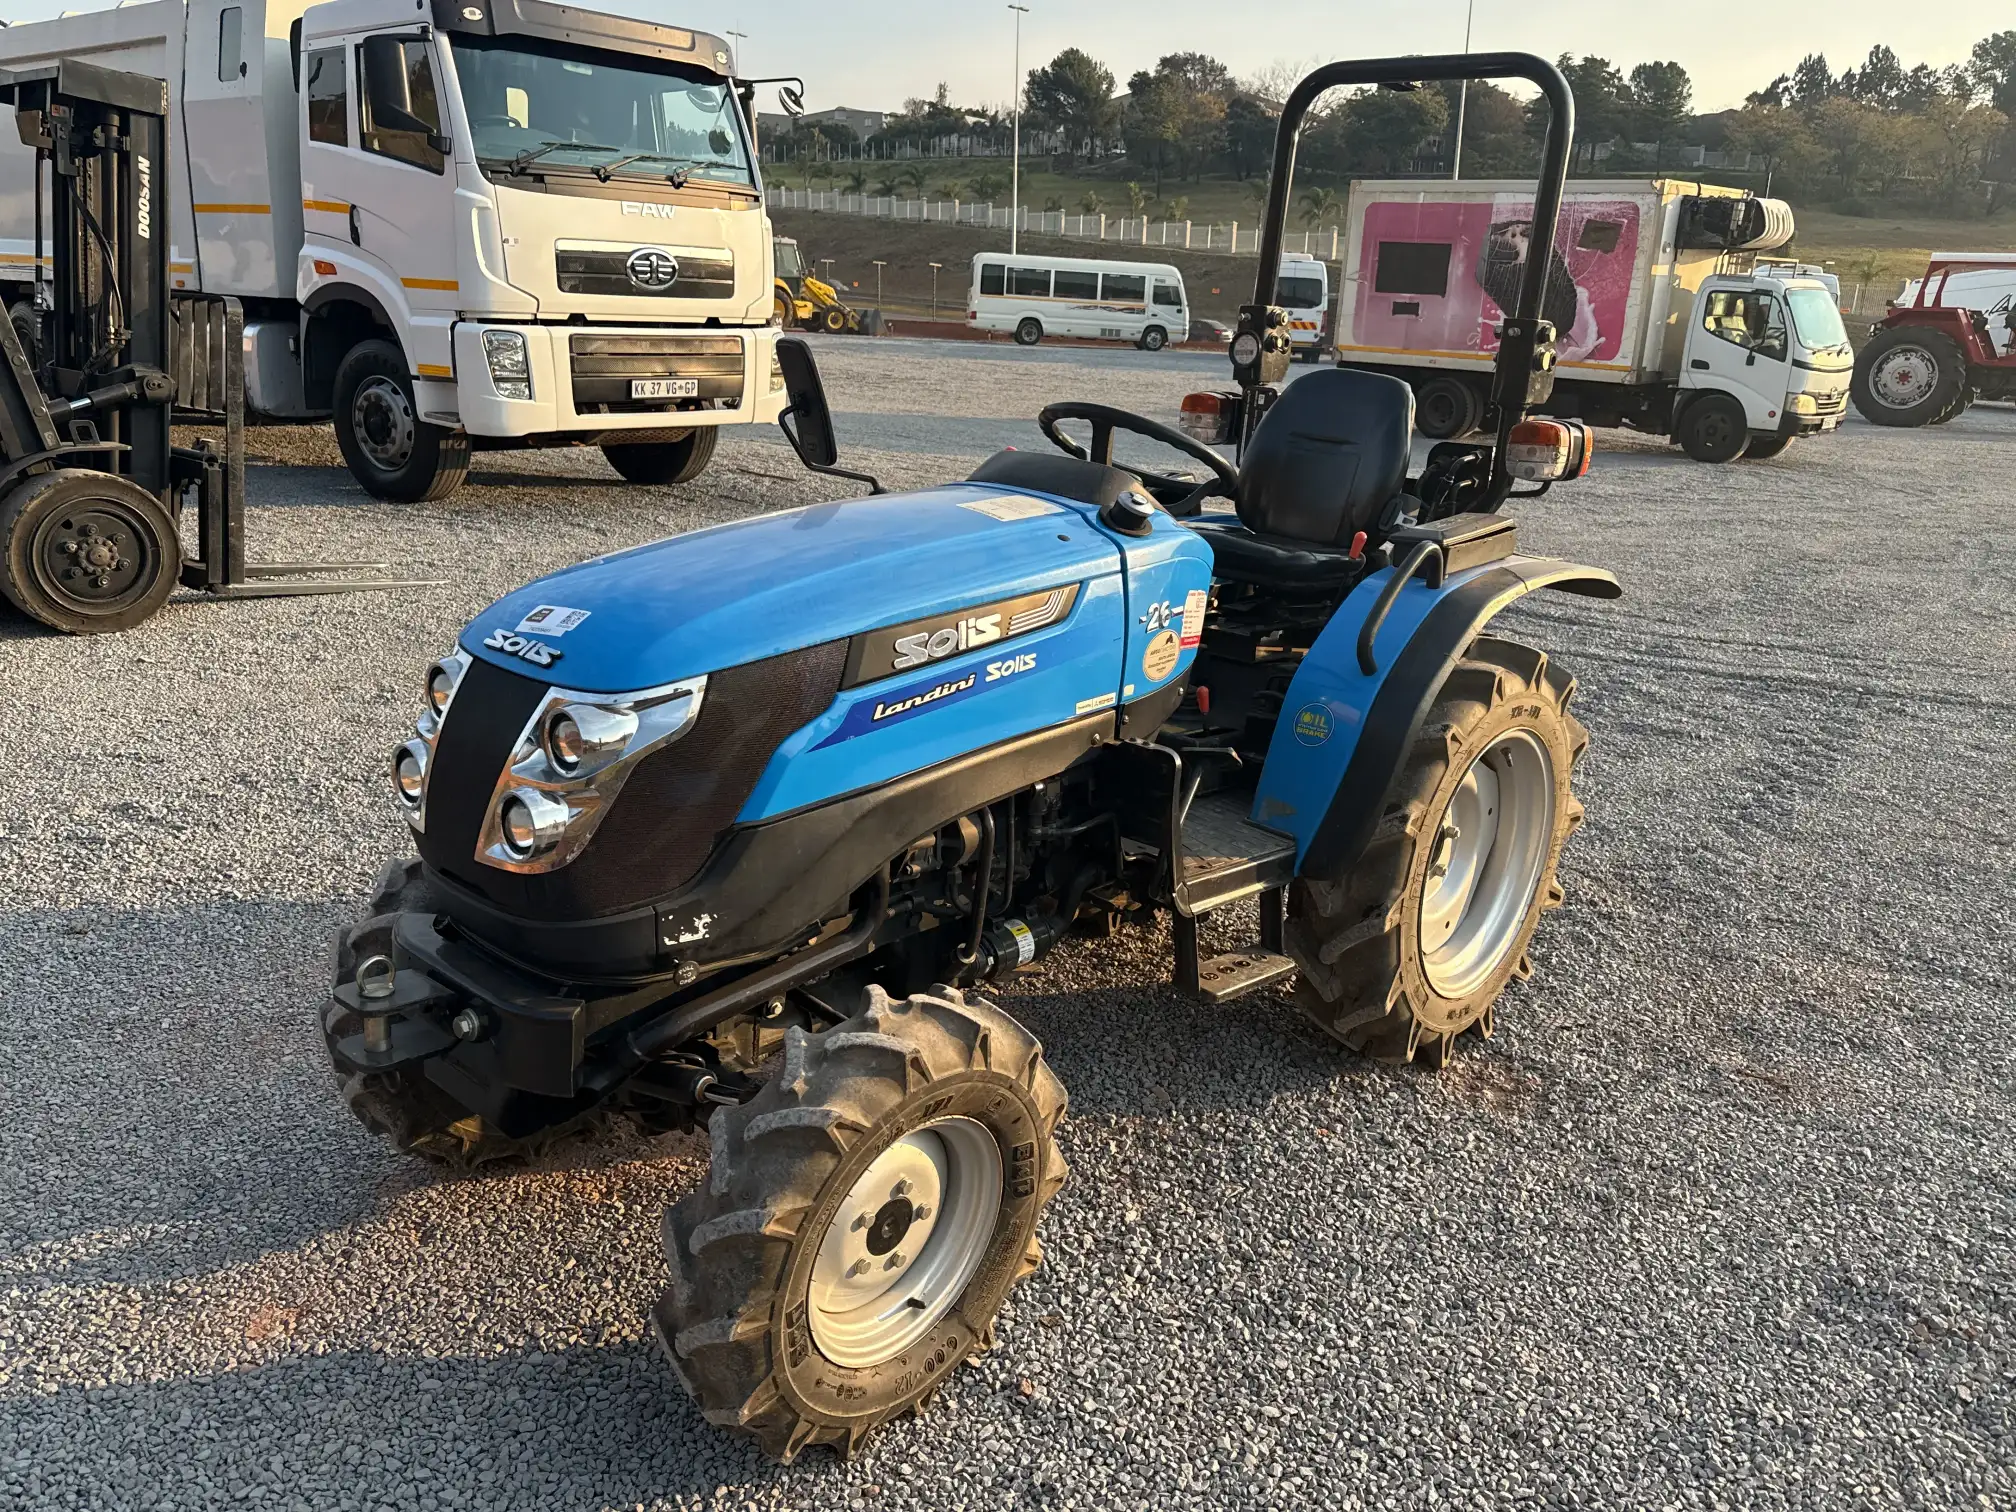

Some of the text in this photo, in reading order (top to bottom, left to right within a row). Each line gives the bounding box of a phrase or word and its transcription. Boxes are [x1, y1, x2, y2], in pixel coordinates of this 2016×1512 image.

[138, 155, 150, 239] DOOSAN
[621, 200, 676, 219] FAW
[634, 380, 696, 396] KK 37 VG GP
[872, 673, 977, 721] Landini
[679, 964, 694, 975] PULL
[683, 971, 692, 979] TO
